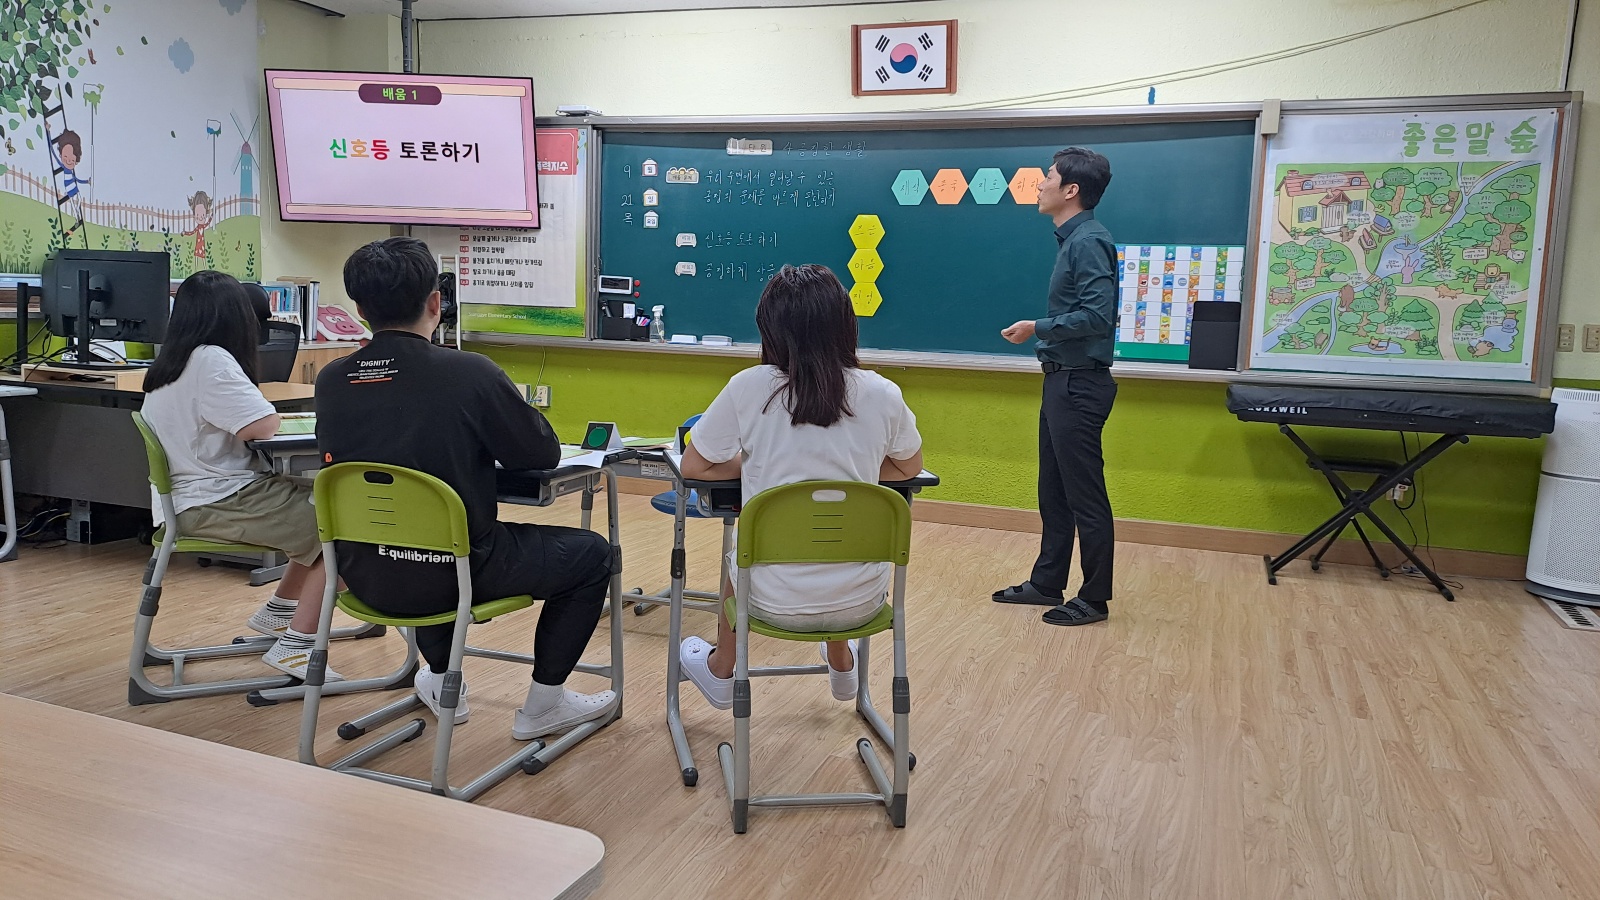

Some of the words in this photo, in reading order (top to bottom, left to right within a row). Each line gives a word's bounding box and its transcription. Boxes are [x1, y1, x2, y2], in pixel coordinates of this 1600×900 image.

[382, 87, 407, 102] 배움
[411, 90, 417, 101] 1
[1509, 118, 1538, 155] 숲
[329, 137, 390, 161] 신호등
[399, 141, 480, 163] 토론하기
[798, 141, 834, 157] 공정한
[842, 141, 866, 158] 생활
[623, 164, 631, 178] 9
[705, 169, 722, 184] 우리
[769, 170, 794, 186] 일어날
[797, 171, 806, 184] 수
[817, 170, 834, 185] 있는
[620, 194, 633, 207] 21
[739, 189, 766, 206] 문제를
[772, 189, 799, 207] 바르게
[804, 188, 835, 207] 판단하기
[623, 212, 633, 225] 목
[705, 231, 733, 248] 신호등
[704, 261, 748, 281] 공정하게
